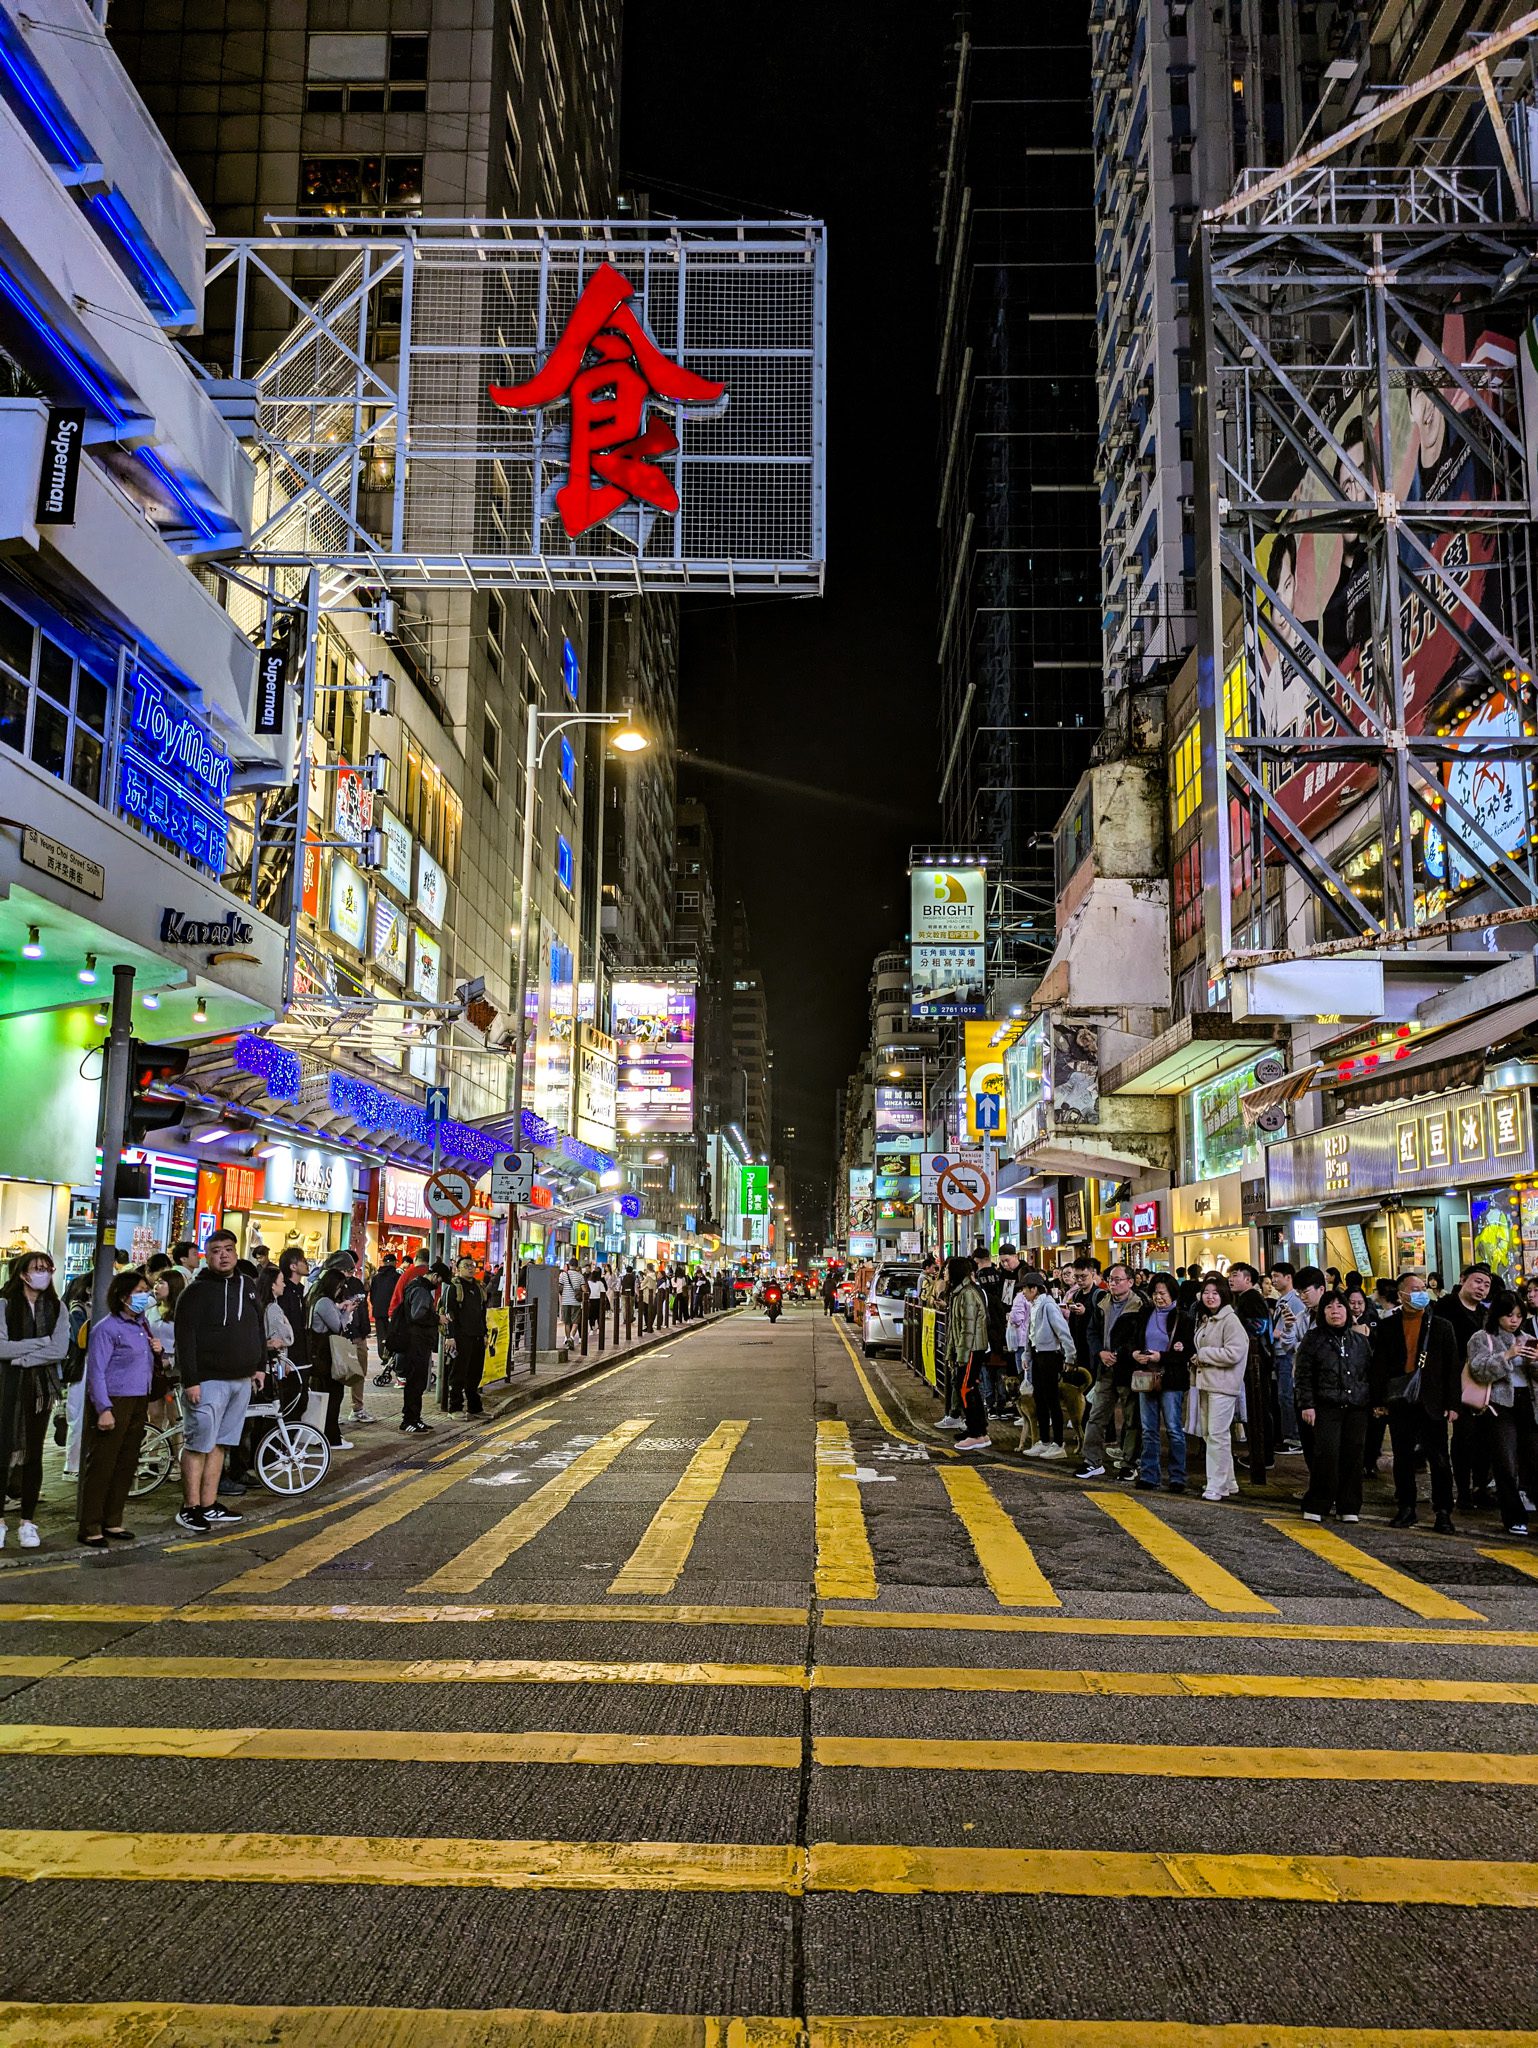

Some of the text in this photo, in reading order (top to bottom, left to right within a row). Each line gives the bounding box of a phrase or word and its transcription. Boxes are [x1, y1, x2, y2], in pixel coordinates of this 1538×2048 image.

[489, 262, 729, 540] 食
[49, 419, 78, 513] Superman
[263, 656, 283, 727] Superman
[40, 838, 55, 854] Yeung
[56, 846, 69, 860] Choi
[69, 853, 87, 870] Street
[86, 863, 100, 877] South
[47, 855, 84, 885] 西洋菜南街
[923, 905, 975, 916] BRIGHT
[160, 907, 254, 946] Karaoke
[920, 949, 976, 957] 旺角銀城廣場
[920, 958, 976, 967] 分租寫字樓
[1324, 1135, 1348, 1158] RED
[1400, 1108, 1516, 1162] 紅豆冰室
[1325, 1159, 1348, 1179] Bean
[517, 1176, 525, 1187] 7
[517, 1192, 529, 1202] 12
[1118, 1223, 1127, 1234] K
